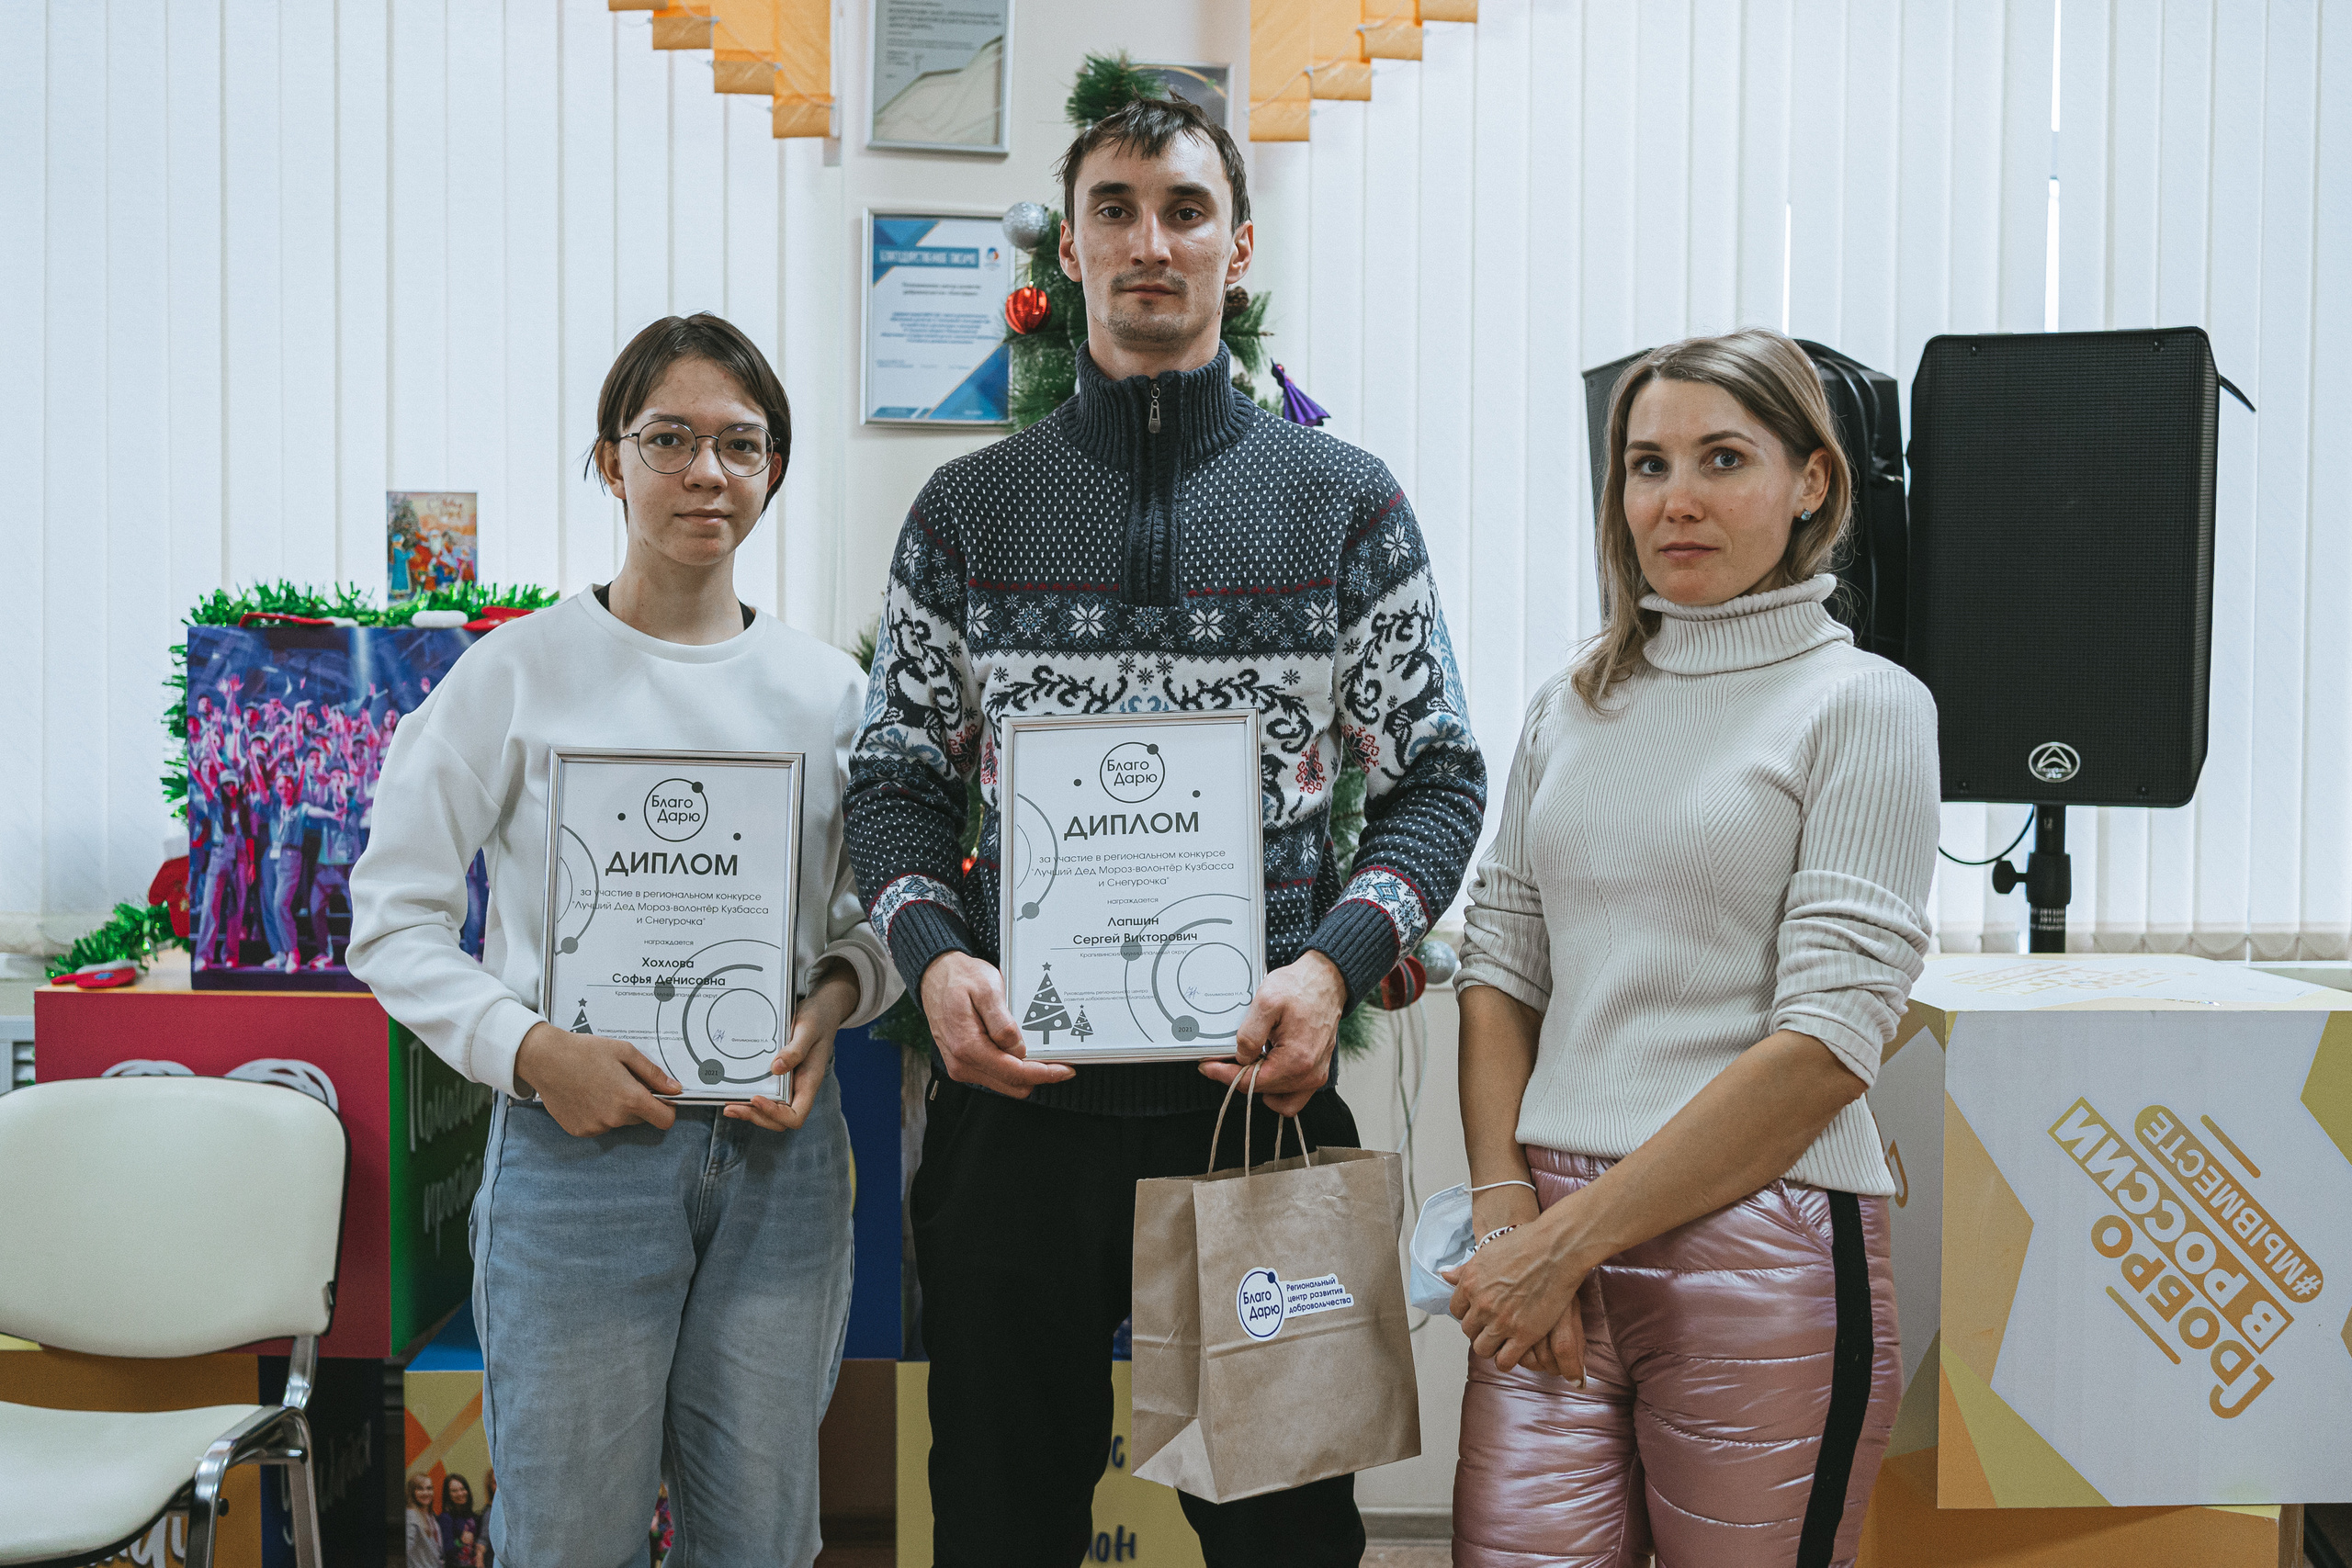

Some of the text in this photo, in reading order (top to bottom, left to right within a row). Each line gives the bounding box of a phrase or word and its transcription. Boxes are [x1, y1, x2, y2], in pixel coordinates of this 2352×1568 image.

[1106, 759, 1149, 772] Благо
[1114, 773, 1158, 786] Дарю
[652, 795, 693, 808] Благо
[657, 809, 700, 825] Дарю
[1064, 811, 1199, 841] ДИПЛОМ
[605, 851, 738, 877] ДИПЛОМ
[1054, 854, 1093, 866] участие
[1103, 851, 1176, 863] региональном
[1178, 850, 1226, 861] конкурсе
[1075, 867, 1097, 876] Дед
[1099, 863, 1182, 876] Мороз-волонтёр
[1185, 862, 1235, 873] Кузбасса
[594, 889, 632, 898] участие
[636, 890, 641, 898] в
[643, 891, 713, 901] региональном
[716, 893, 762, 902] конкурсе
[1107, 897, 1159, 906] награждается
[614, 902, 636, 912] Дед
[638, 902, 718, 915] Мороз-волонтёр
[721, 904, 769, 915] Кузбасса
[1107, 917, 1159, 928] Лапшин
[1073, 931, 1198, 948] Сергей Викторович
[641, 957, 695, 968] Хохлова
[612, 973, 726, 987] Софья Денисовна
[2053, 1104, 2251, 1309] РОССИИ
[2142, 1111, 2323, 1297] #МЫВМЕСТЕ
[1286, 1277, 1336, 1292] Региональный
[1243, 1291, 1272, 1304] Благо
[1288, 1288, 1343, 1303] центр развития
[2090, 1213, 2256, 1387] ДОБРО
[1250, 1304, 1281, 1321] Дарю
[1289, 1297, 1351, 1314] добровольчества
[2240, 1300, 2289, 1349] В
